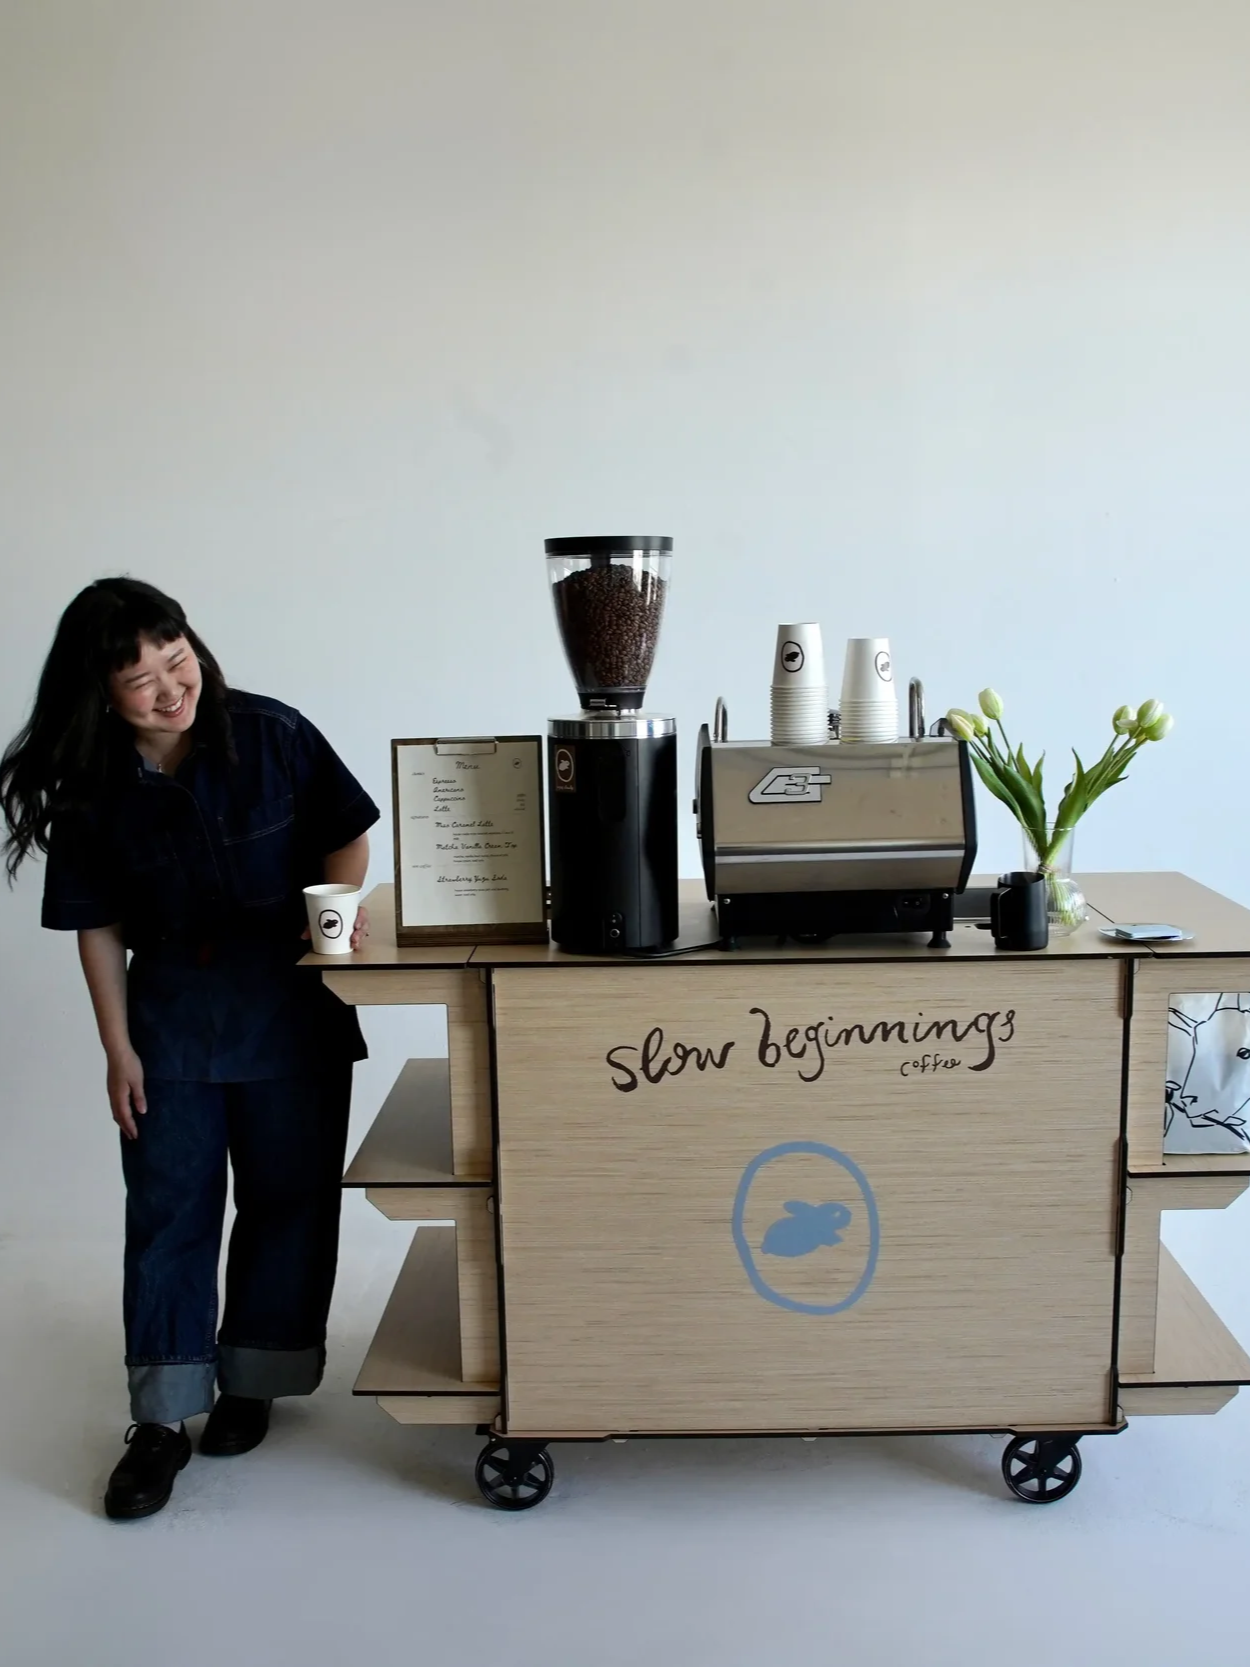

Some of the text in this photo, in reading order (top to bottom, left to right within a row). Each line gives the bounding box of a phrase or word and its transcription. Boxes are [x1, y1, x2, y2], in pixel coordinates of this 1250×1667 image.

[606, 1007, 1016, 1093] slow beginnings
[900, 1054, 962, 1077] coffee
